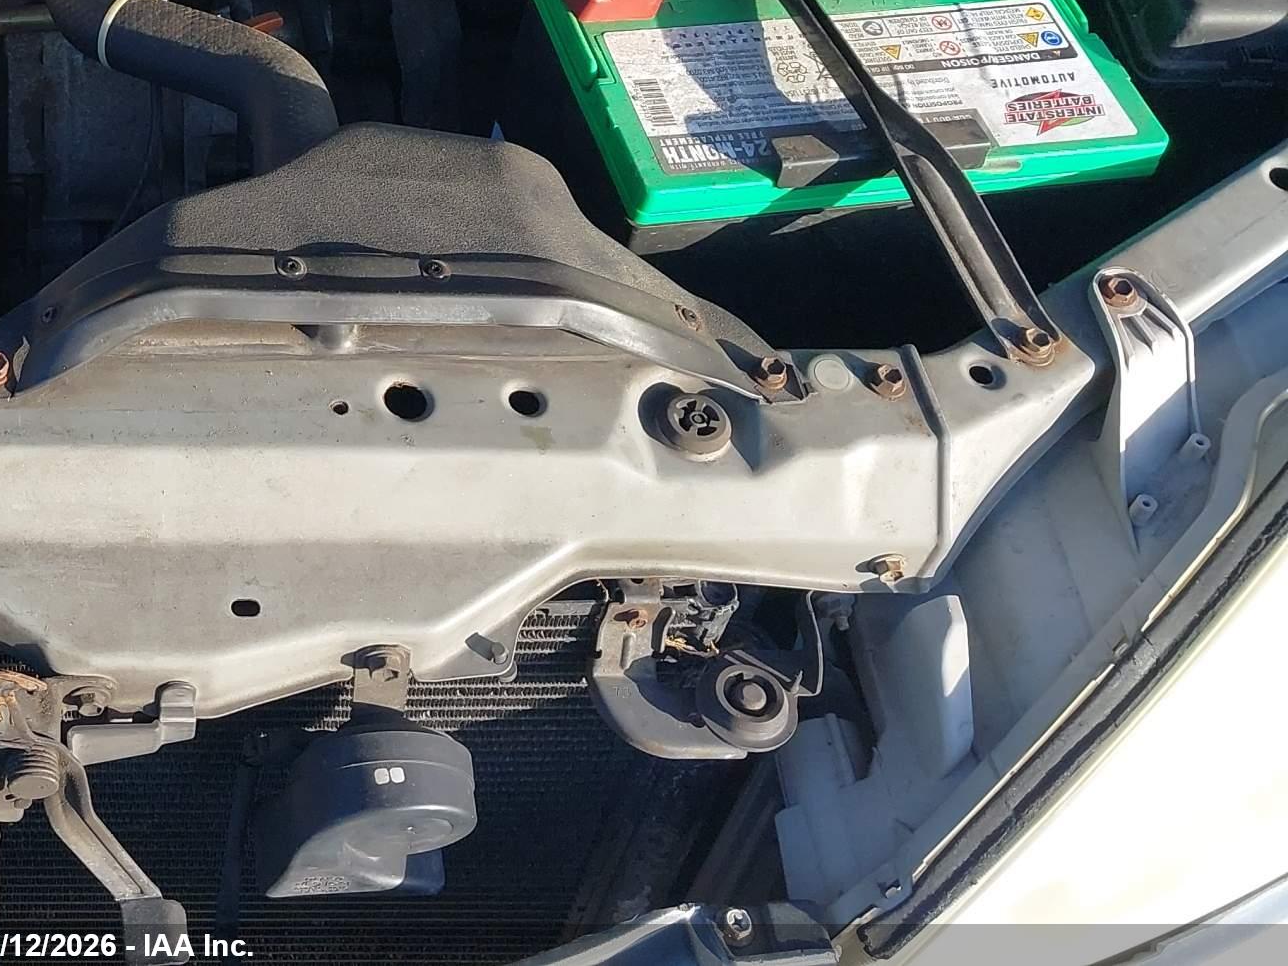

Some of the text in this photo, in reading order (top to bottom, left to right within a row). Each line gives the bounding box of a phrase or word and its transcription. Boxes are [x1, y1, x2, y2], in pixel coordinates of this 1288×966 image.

[941, 52, 1041, 68] DANGER/POISON
[990, 71, 1076, 89] AUTOMOTIVE
[1005, 94, 1093, 113] BATTERIES
[1005, 103, 1105, 124] INTERSTATE
[658, 133, 733, 146] REPLACEMENT
[660, 138, 771, 164] 24-MONTH
